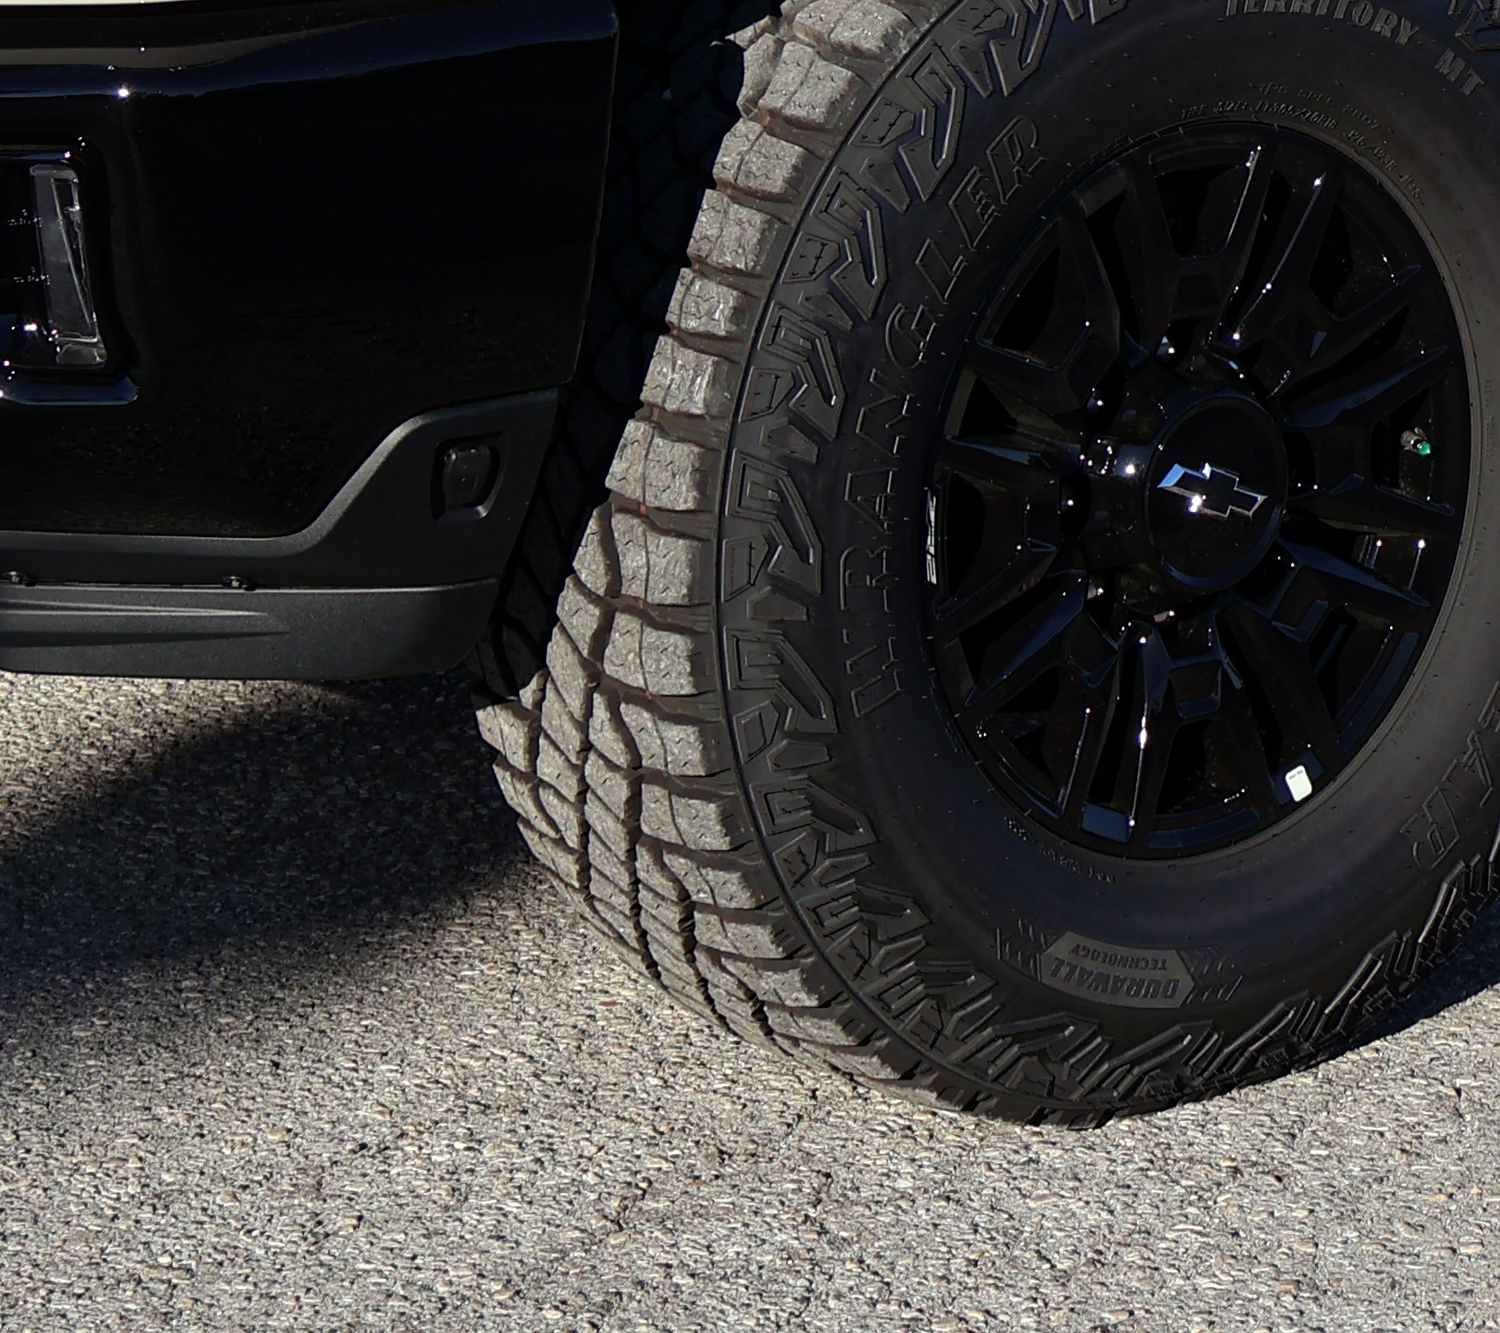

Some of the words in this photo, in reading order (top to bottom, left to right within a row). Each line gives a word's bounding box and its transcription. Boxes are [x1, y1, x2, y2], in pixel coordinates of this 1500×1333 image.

[840, 114, 1049, 719] WRANGLER
[1434, 47, 1486, 97] MT
[1049, 955, 1181, 1000] DURAWALL
[1068, 943, 1168, 971] TECHNOLOGY
